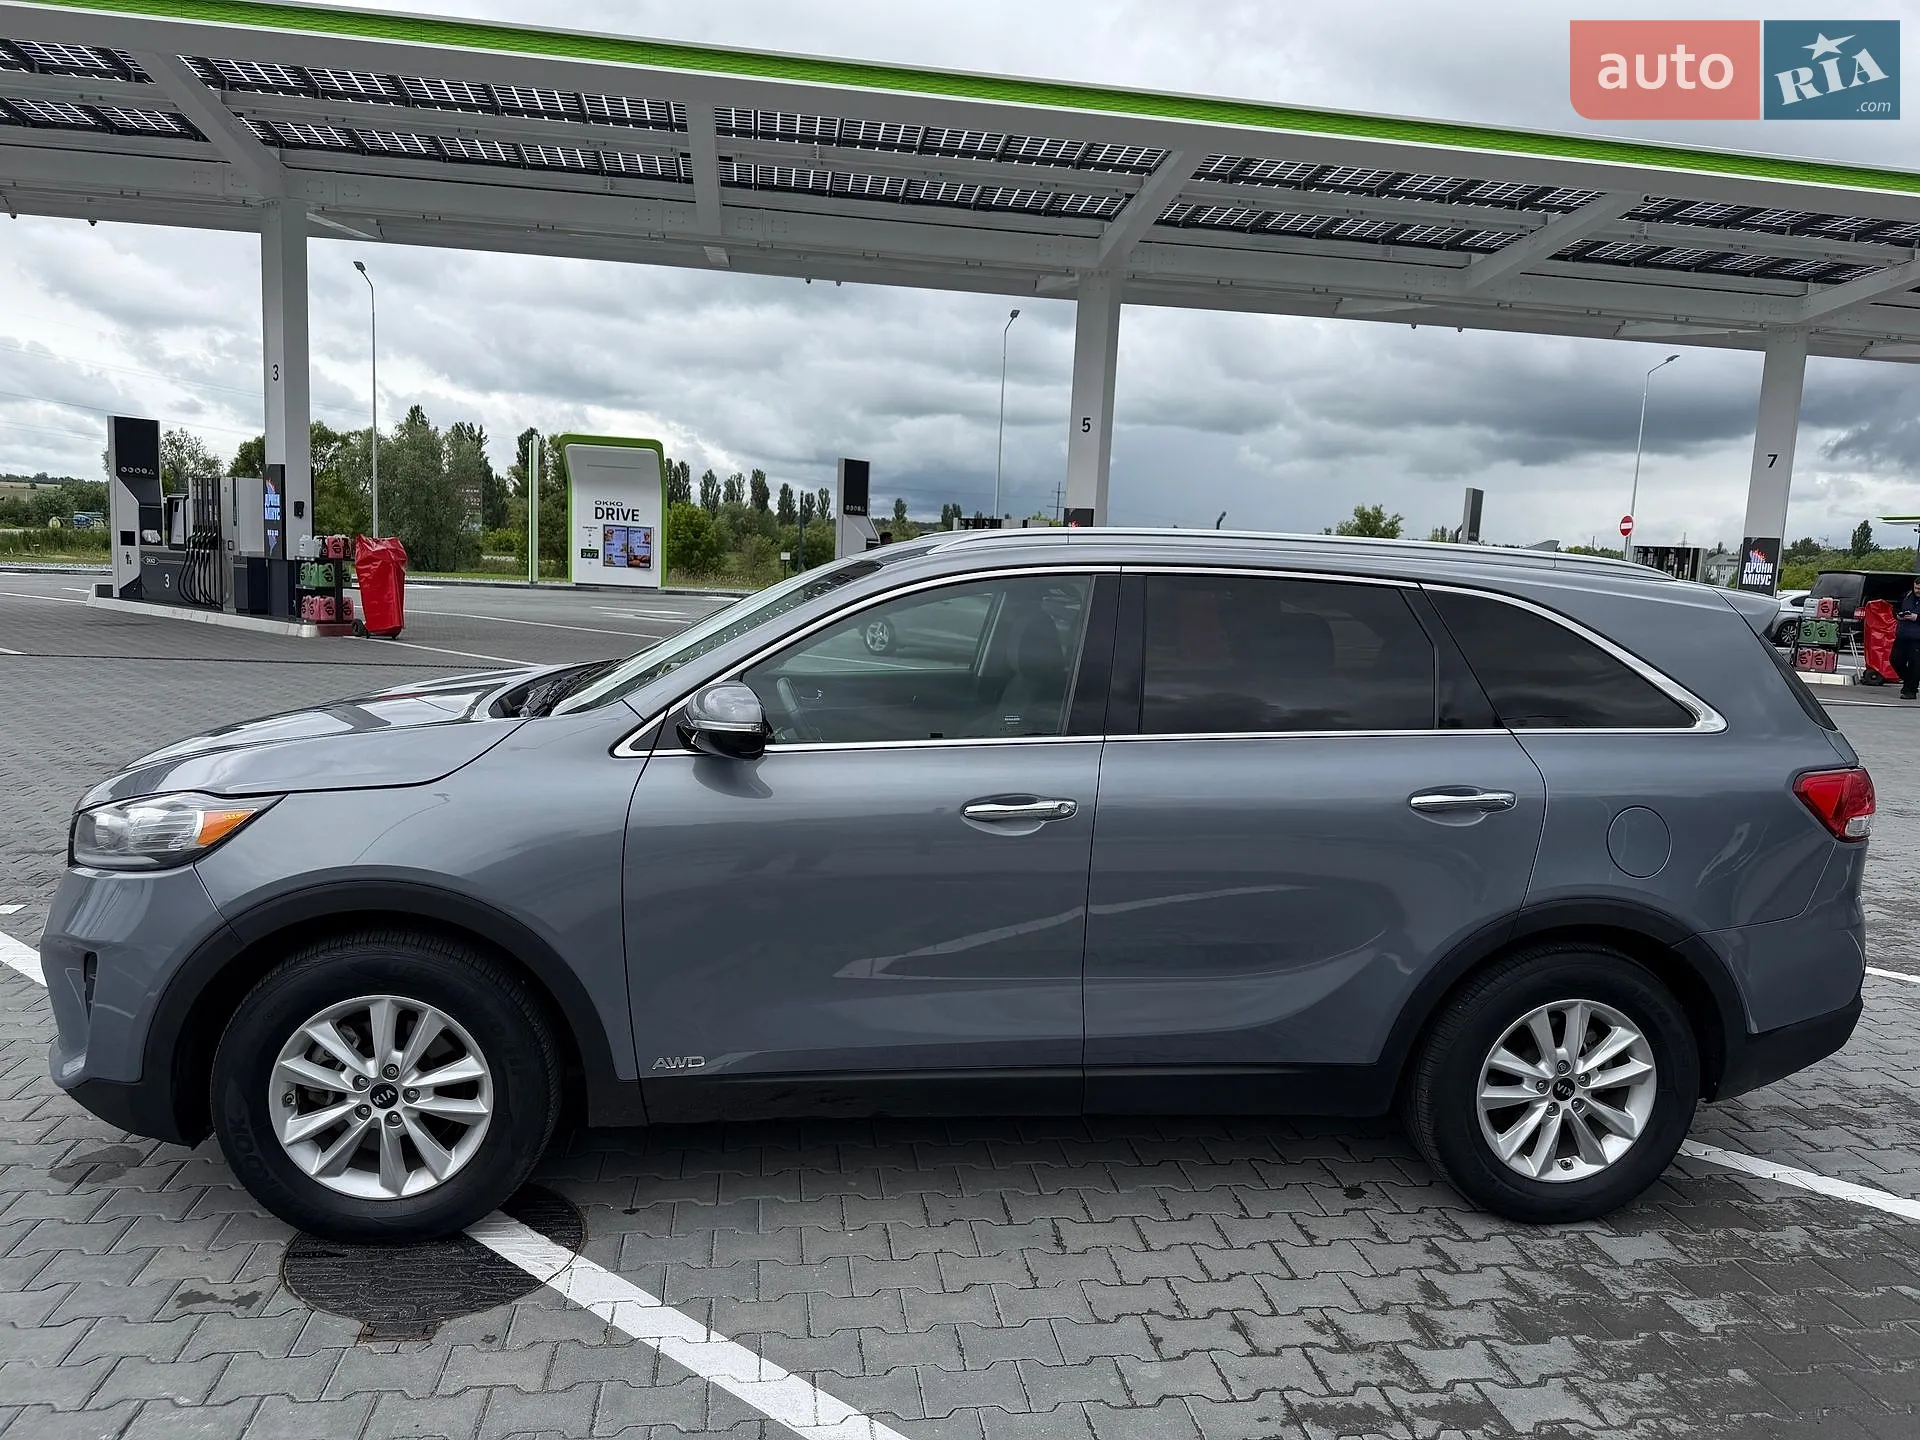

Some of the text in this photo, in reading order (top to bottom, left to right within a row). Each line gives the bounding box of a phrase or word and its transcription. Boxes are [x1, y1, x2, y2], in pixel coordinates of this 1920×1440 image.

[272, 363, 279, 381] 3
[1081, 417, 1091, 433] 5
[1767, 454, 1778, 468] 7
[594, 506, 640, 522] DRIVE
[1743, 561, 1774, 574] ДРОНИ
[164, 573, 170, 588] 3
[1742, 574, 1772, 586] МІНУС
[651, 1056, 706, 1070] AWD
[372, 1089, 396, 1105] KIA
[1556, 1082, 1574, 1097] KIA
